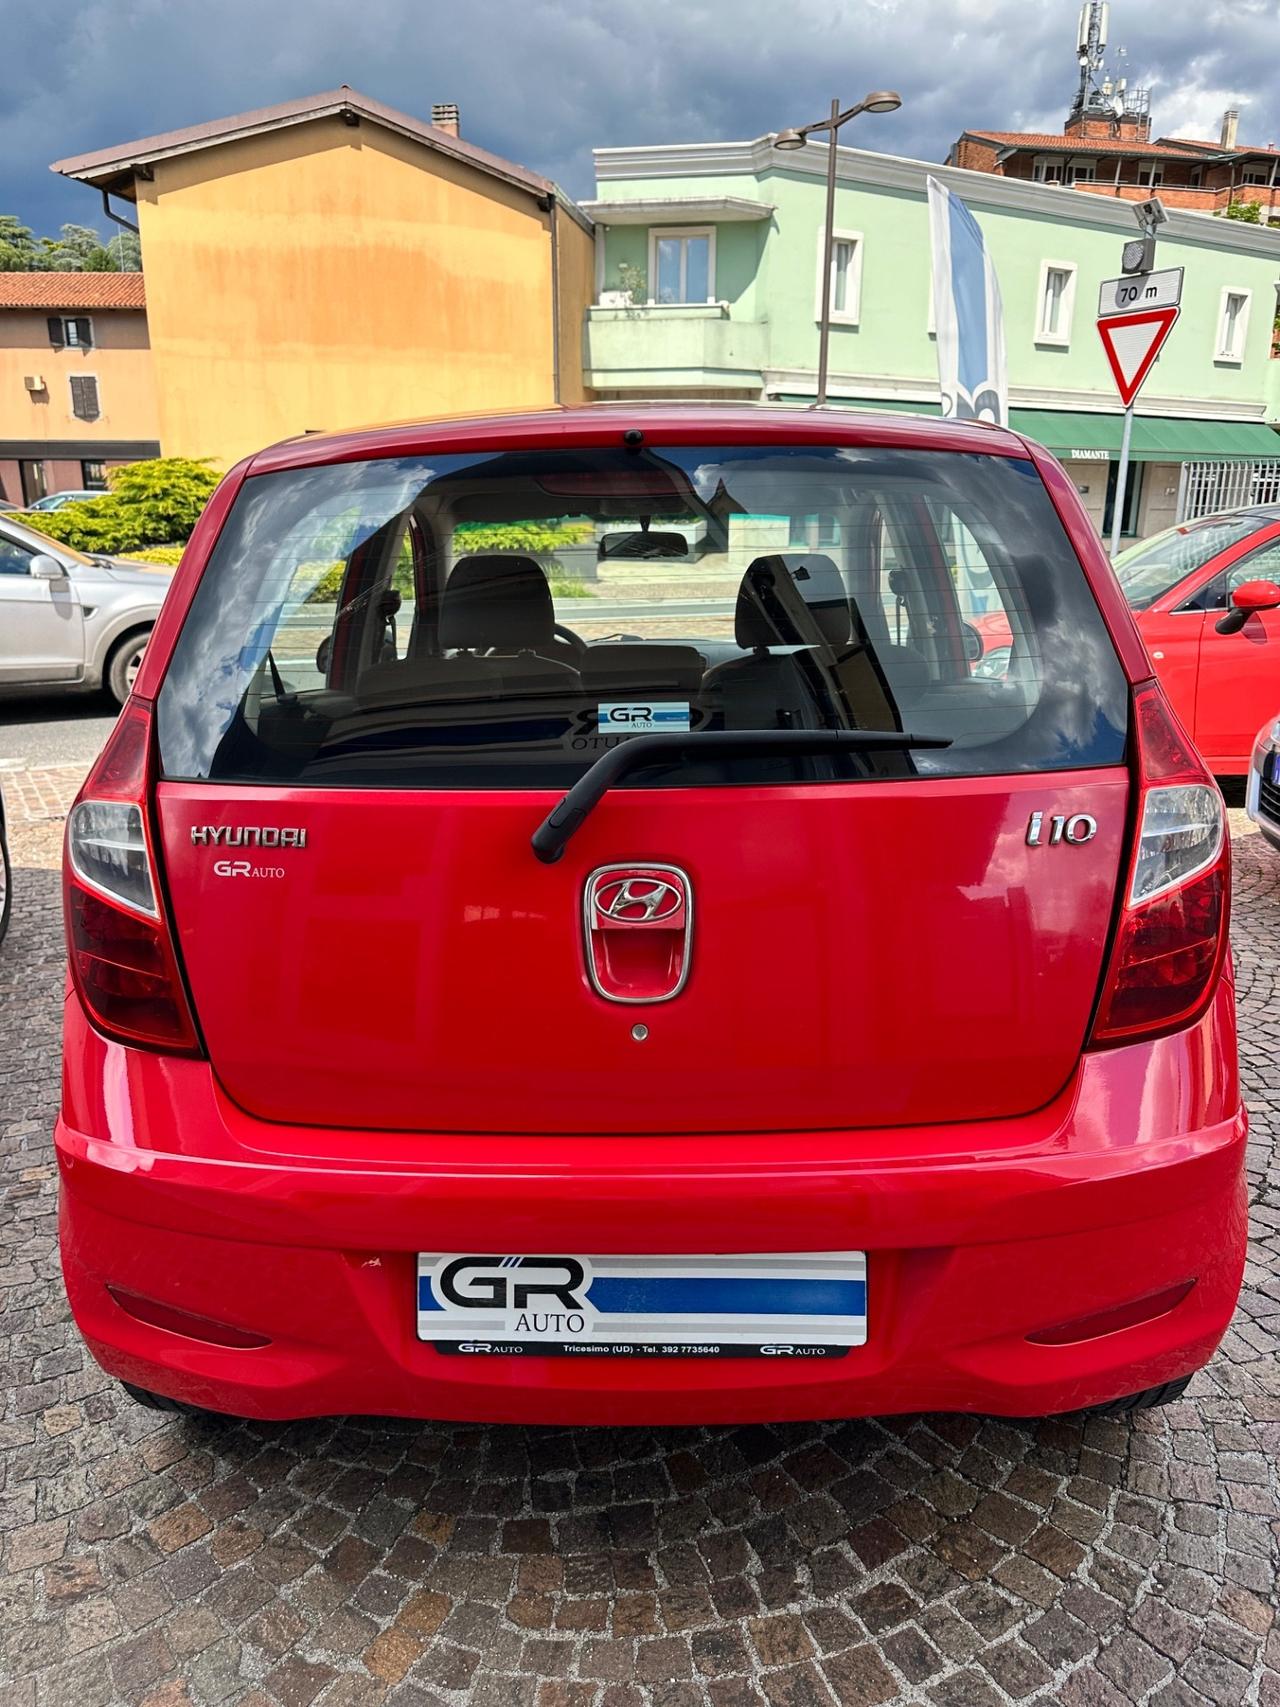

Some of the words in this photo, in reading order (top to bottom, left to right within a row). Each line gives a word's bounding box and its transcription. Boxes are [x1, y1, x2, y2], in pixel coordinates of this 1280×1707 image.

[1121, 286, 1138, 303] 70
[1145, 286, 1158, 299] m
[1071, 449, 1110, 460] DIAMANTE
[610, 706, 653, 722] GR
[190, 825, 307, 848] HYUNDAI
[1026, 810, 1098, 846] i10
[213, 860, 252, 878] GR
[252, 867, 286, 879] AUTO
[439, 1256, 585, 1311] GR
[514, 1313, 586, 1334] AUTO
[457, 1342, 492, 1354] GR
[493, 1345, 523, 1354] AUTO
[563, 1344, 610, 1353] Tricesimo
[612, 1344, 634, 1354] (UD)
[642, 1345, 659, 1354] Tel.
[661, 1345, 679, 1354] 392
[681, 1345, 720, 1354] 7735640
[759, 1344, 794, 1356] GR
[795, 1347, 826, 1356] AUTO
